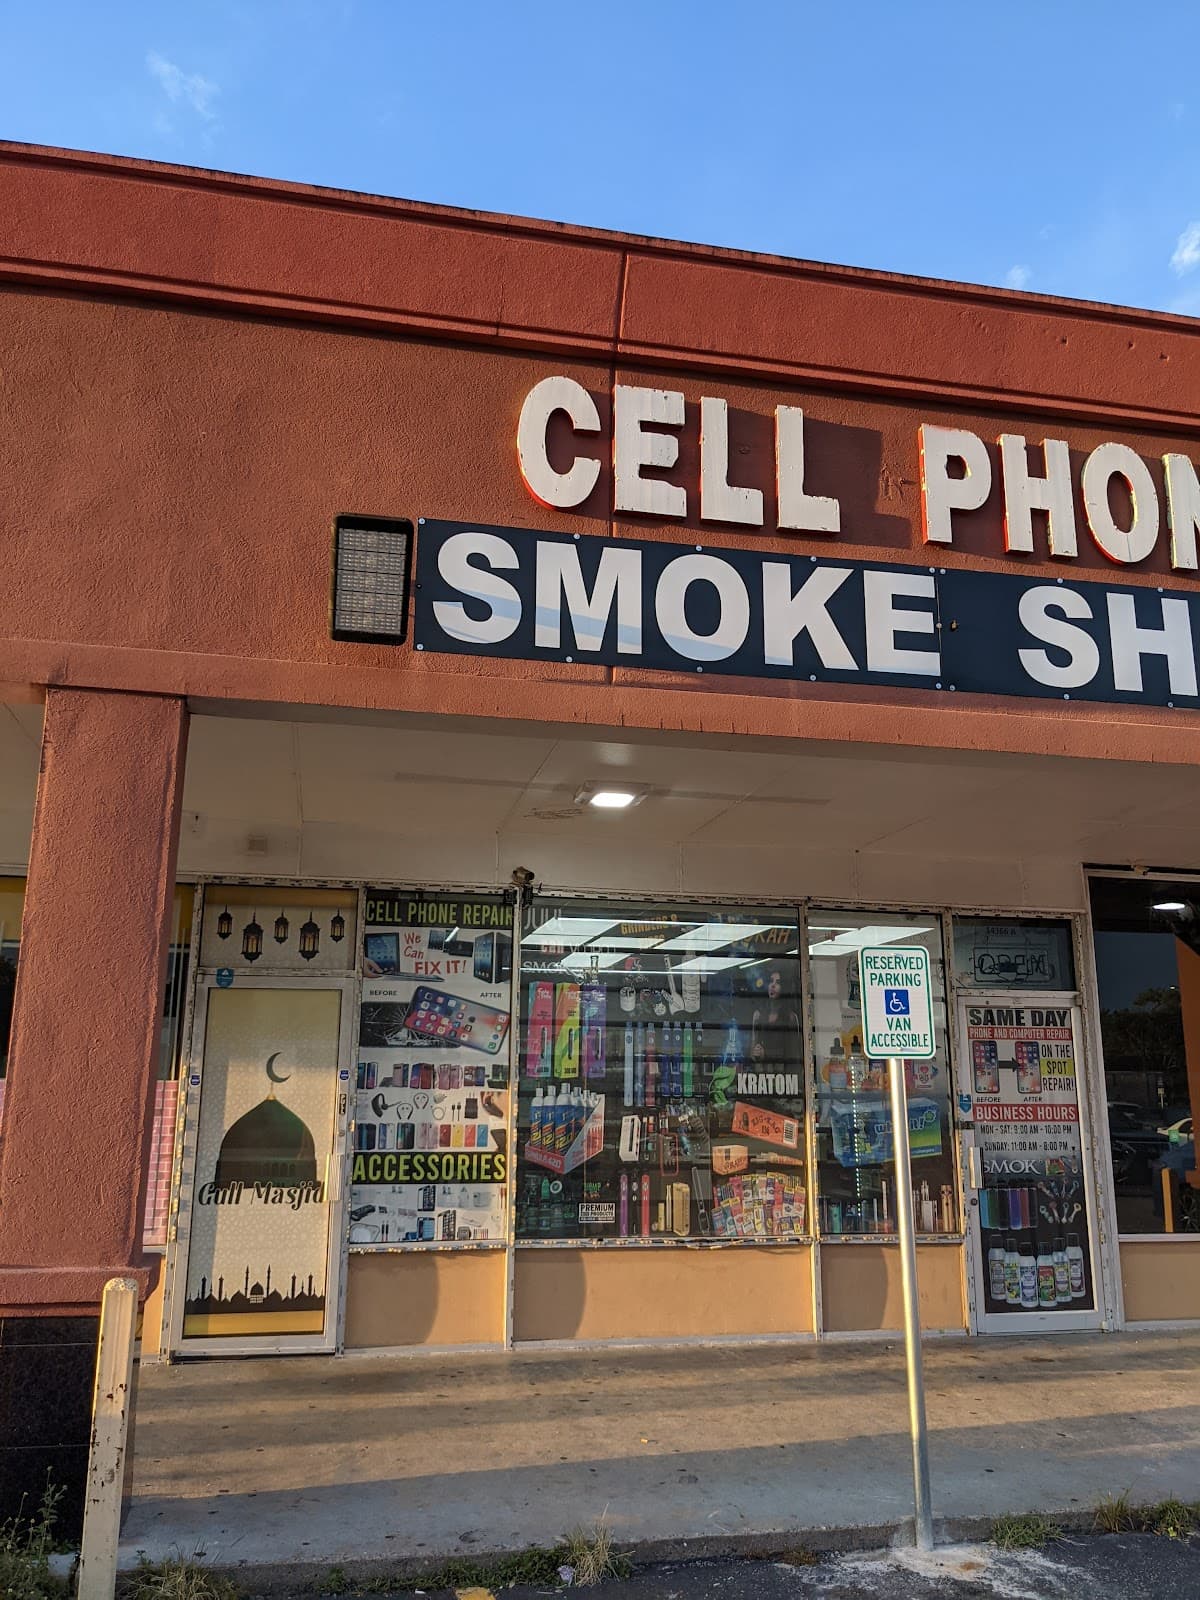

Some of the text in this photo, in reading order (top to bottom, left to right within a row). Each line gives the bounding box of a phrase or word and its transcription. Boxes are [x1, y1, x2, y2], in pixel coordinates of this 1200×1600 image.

[517, 376, 840, 533] CELL
[433, 532, 1199, 697] SMOKE SH
[366, 900, 513, 926] CELL PHONE REPAIR
[404, 931, 422, 945] We
[404, 946, 425, 960] Can
[415, 960, 467, 975] FIX IT!
[865, 956, 923, 970] RESERVED
[870, 973, 921, 987] PARKING
[886, 1018, 912, 1031] VAN
[969, 1010, 1068, 1027] SAME DAY
[871, 1033, 929, 1048] ACCESSIBLE
[970, 1028, 1070, 1040] PHONE AND COMPUTER REPAIR
[1041, 1044, 1070, 1058] ON THE
[1046, 1061, 1067, 1074] SPOT
[737, 1073, 799, 1096] KRATOM
[1042, 1078, 1075, 1092] REPAIR!
[976, 1106, 1076, 1121] BUSINESS HOURS
[980, 1124, 994, 1134] MON
[1000, 1124, 1012, 1134] SAT:
[1029, 1124, 1039, 1134] AM
[1044, 1124, 1061, 1134] 10:00
[1062, 1124, 1072, 1134] PM
[984, 1141, 1010, 1151] SUNDAY:
[1011, 1141, 1027, 1151] 11:00
[1028, 1141, 1038, 1151] AM
[1058, 1141, 1068, 1151] PM
[352, 1153, 506, 1181] ACCESSORIES
[250, 1180, 325, 1211] Masjid
